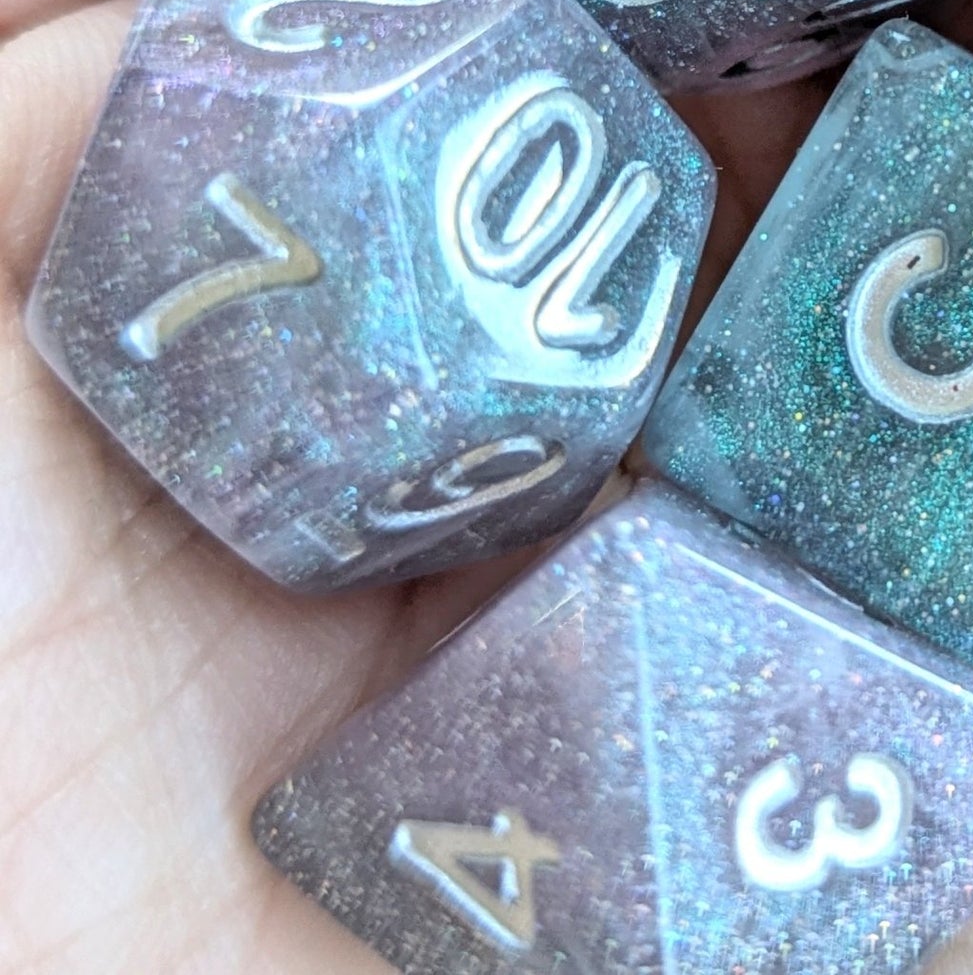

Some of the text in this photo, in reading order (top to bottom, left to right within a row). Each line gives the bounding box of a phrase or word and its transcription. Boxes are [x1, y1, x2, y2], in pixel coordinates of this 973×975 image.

[118, 172, 324, 362] 7
[458, 86, 658, 354] 10
[388, 809, 562, 952] 4
[735, 755, 914, 891] 3
